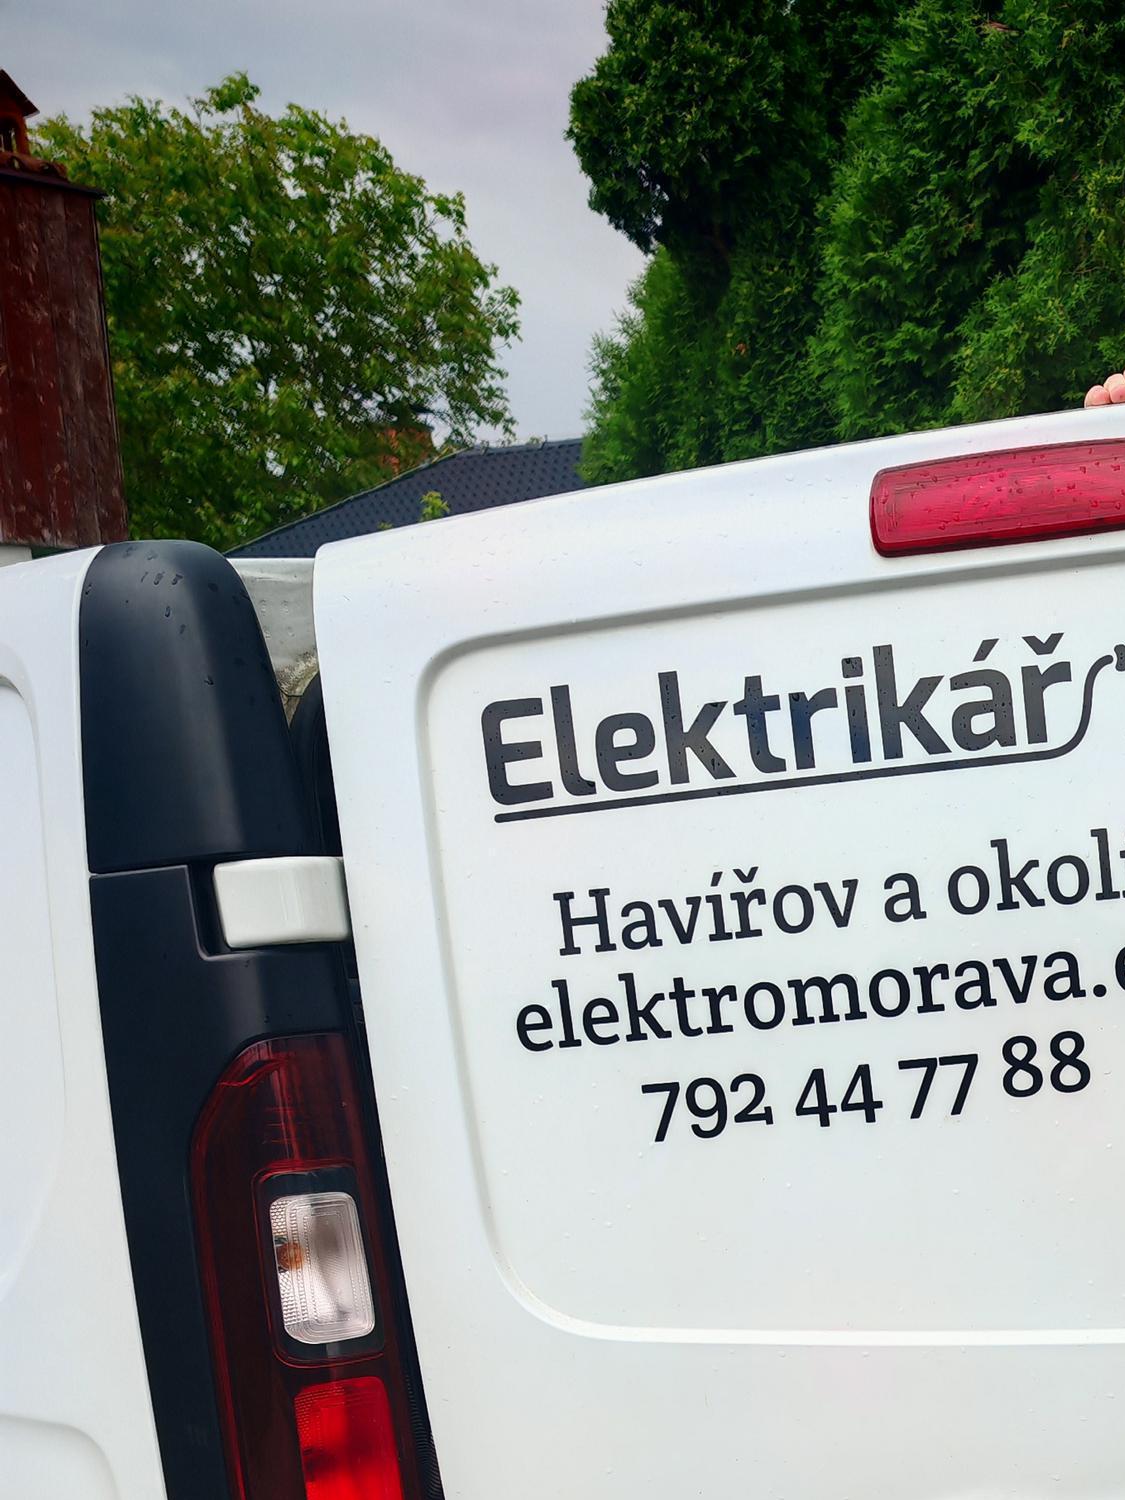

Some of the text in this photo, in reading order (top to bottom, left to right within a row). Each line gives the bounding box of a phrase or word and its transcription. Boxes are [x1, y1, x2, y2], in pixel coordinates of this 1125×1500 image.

[481, 633, 1073, 806] Elektrikář
[553, 867, 859, 956] Havířov
[884, 873, 926, 922] a
[641, 1031, 1091, 1143] 792 44 77 88
